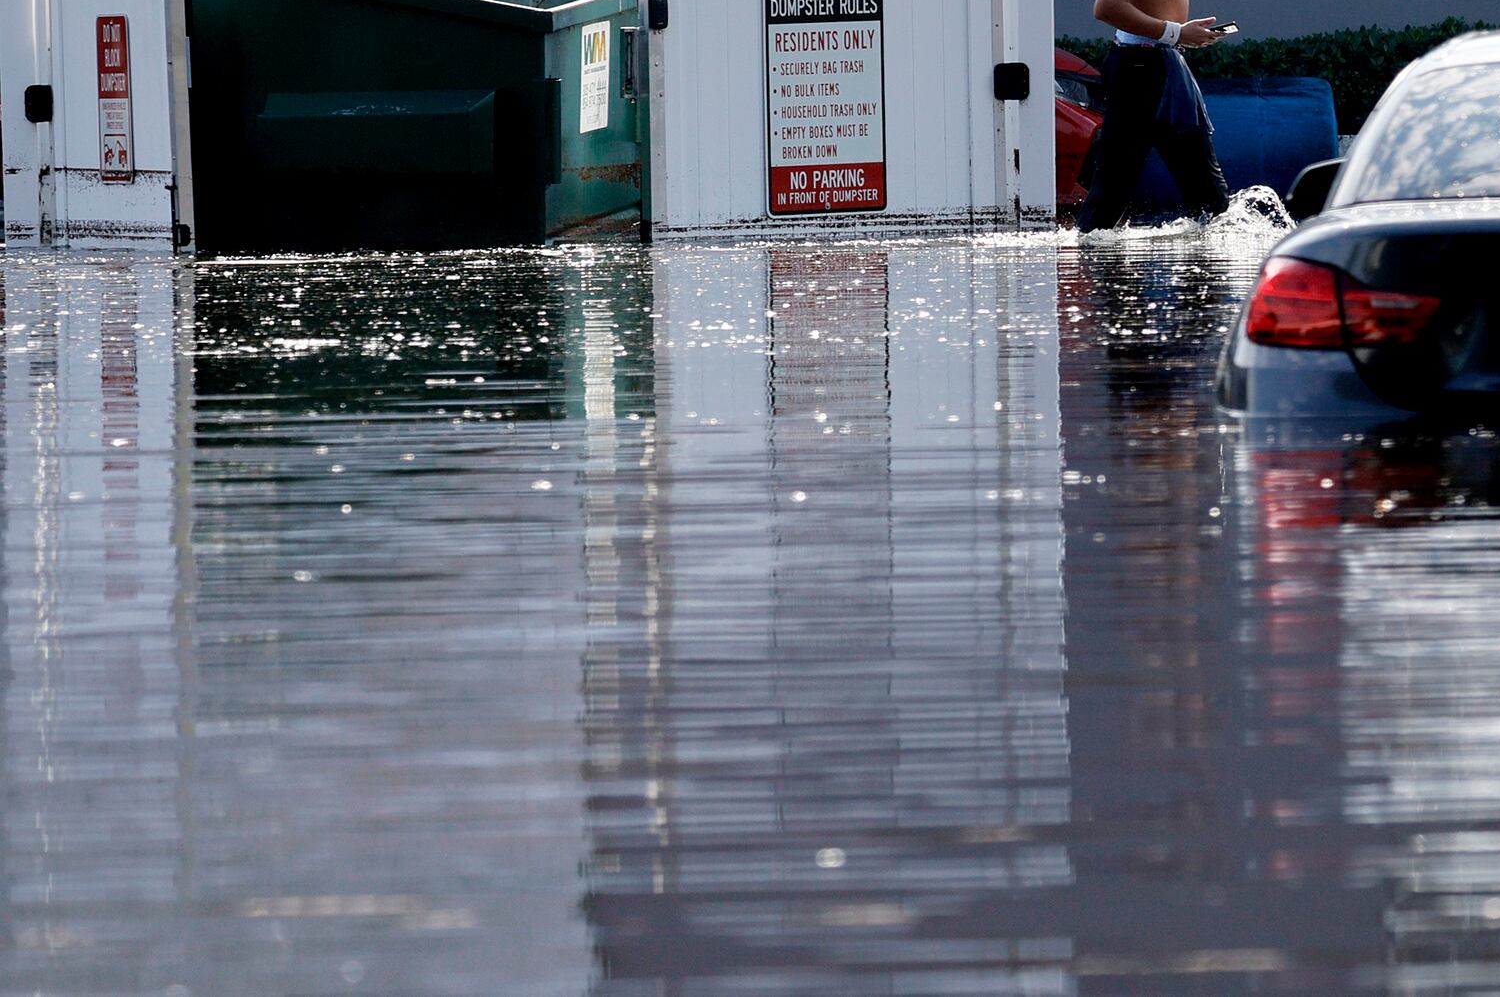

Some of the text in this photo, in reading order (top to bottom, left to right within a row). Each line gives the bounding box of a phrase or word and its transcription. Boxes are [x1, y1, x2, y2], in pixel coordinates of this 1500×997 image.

[103, 23, 121, 43] DO NOT
[775, 29, 875, 52] RESIDENTS ONLY
[583, 31, 606, 65] WM
[104, 49, 121, 67] BLOCK
[780, 60, 864, 75] SECURELY BAG TRASH
[101, 73, 126, 92] DUMPSTER
[781, 83, 840, 97] NO BULK ITEMS
[781, 103, 877, 119] HOUSEHOLD TRASH ONLY
[782, 124, 868, 139] EMPTY BOXES MUST BE
[782, 145, 837, 159] BROKEN DOWN
[790, 169, 865, 189] NO PARKING
[778, 189, 878, 205] IN FRONT OF DUMPSTER
